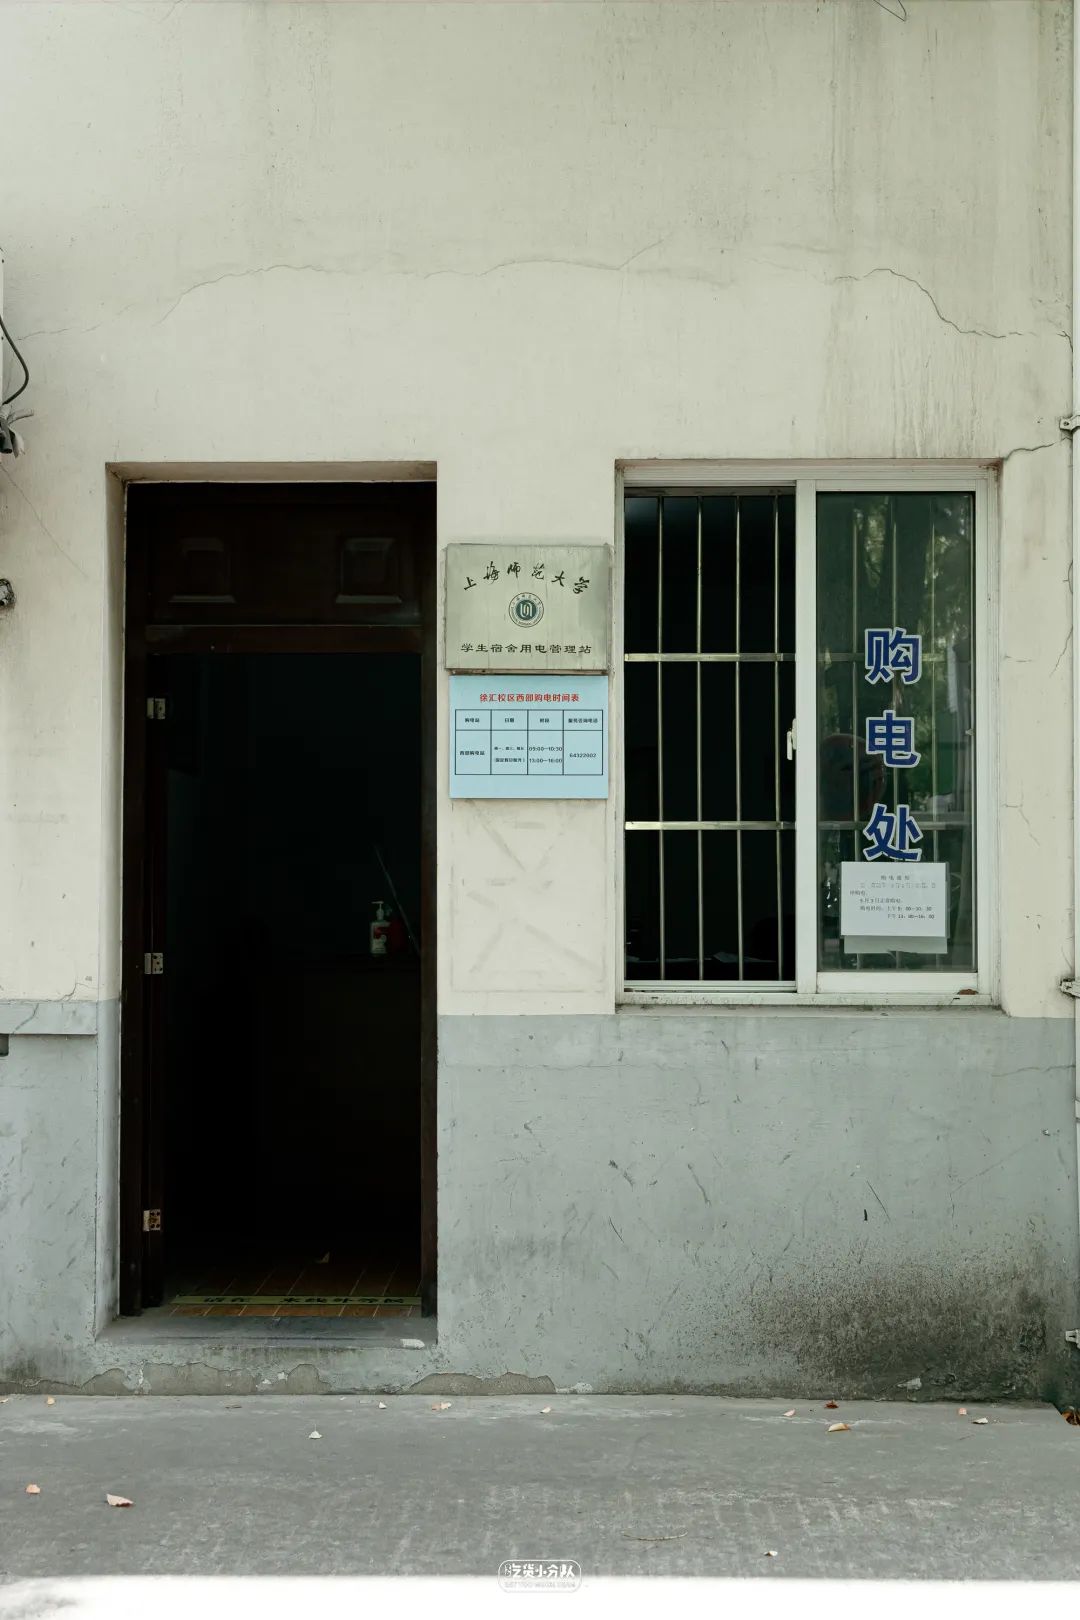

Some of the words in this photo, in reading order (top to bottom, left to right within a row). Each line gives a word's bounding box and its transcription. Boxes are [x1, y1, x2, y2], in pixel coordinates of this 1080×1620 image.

[463, 560, 590, 595] 上海师范大学
[460, 643, 592, 654] 学生宿舍用电管理站
[479, 693, 580, 703] 徐汇校区西部购电时间表
[863, 627, 923, 861] 购电处
